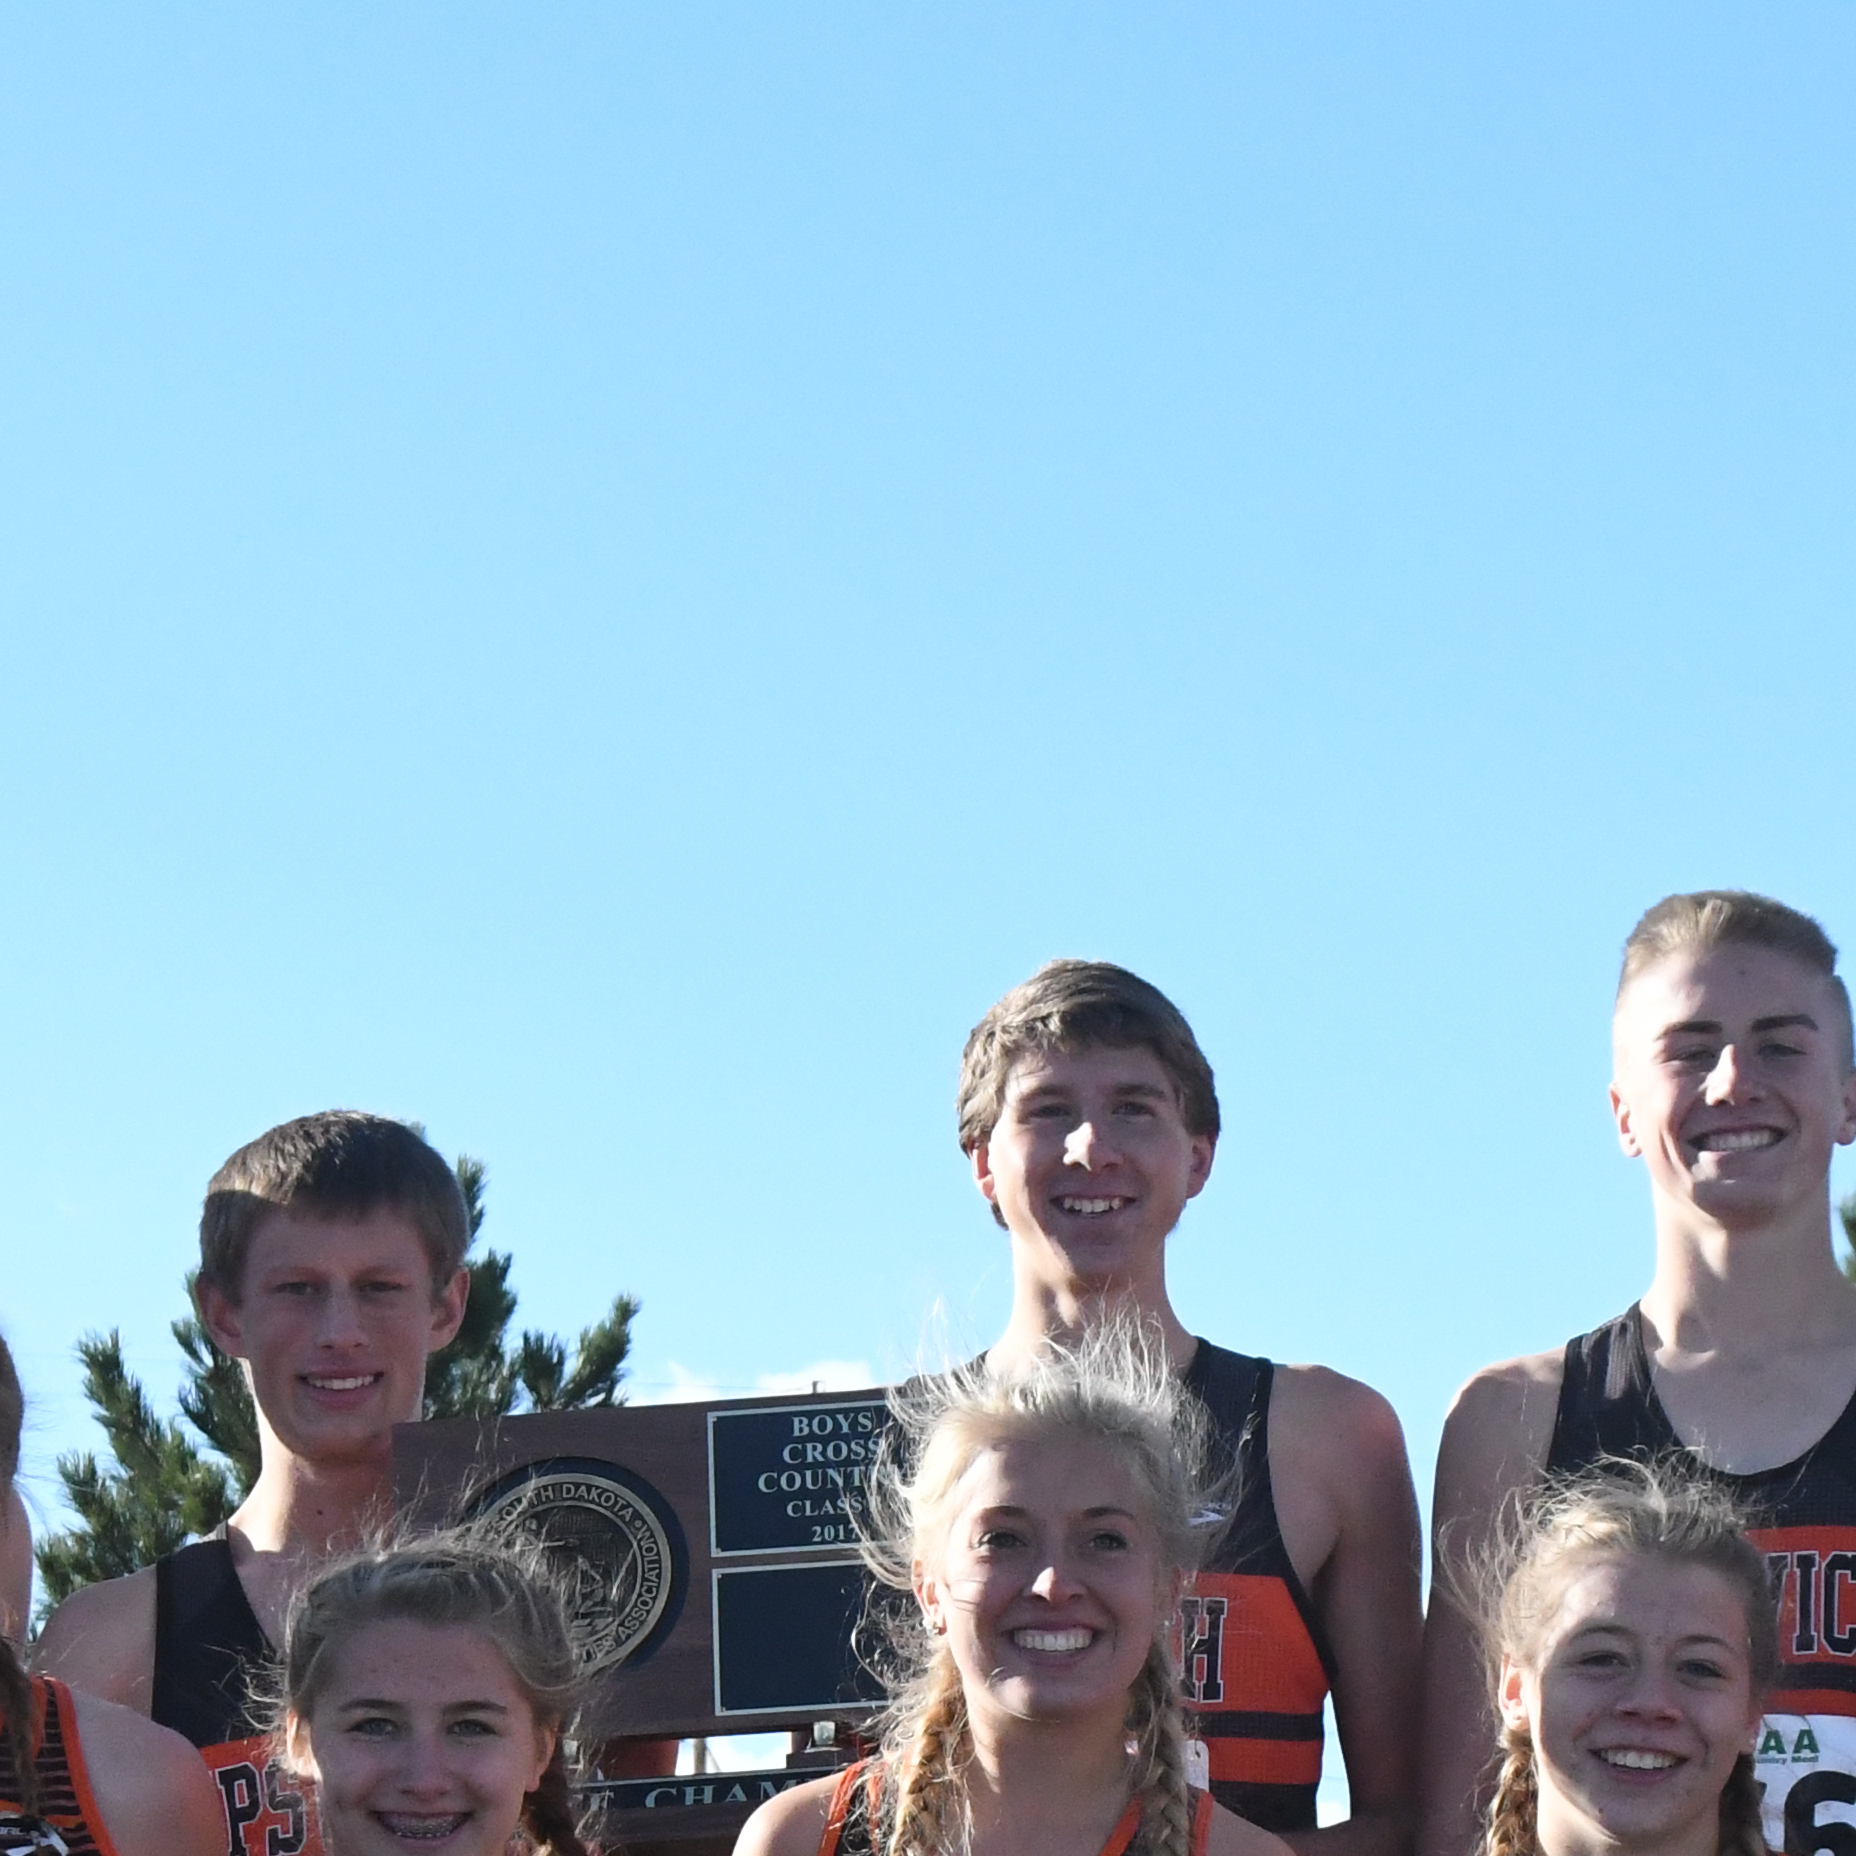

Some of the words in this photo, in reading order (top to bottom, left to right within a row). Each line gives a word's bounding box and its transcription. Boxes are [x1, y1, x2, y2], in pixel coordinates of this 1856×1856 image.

[792, 1412, 872, 1436] BOYS
[782, 1438, 881, 1464] CROSS
[758, 1466, 879, 1493] COUNT
[562, 1484, 635, 1521] DAKOTA
[786, 1497, 863, 1517] CLASS
[812, 1524, 859, 1542] 2017
[617, 1524, 660, 1642] ASSOCIATION
